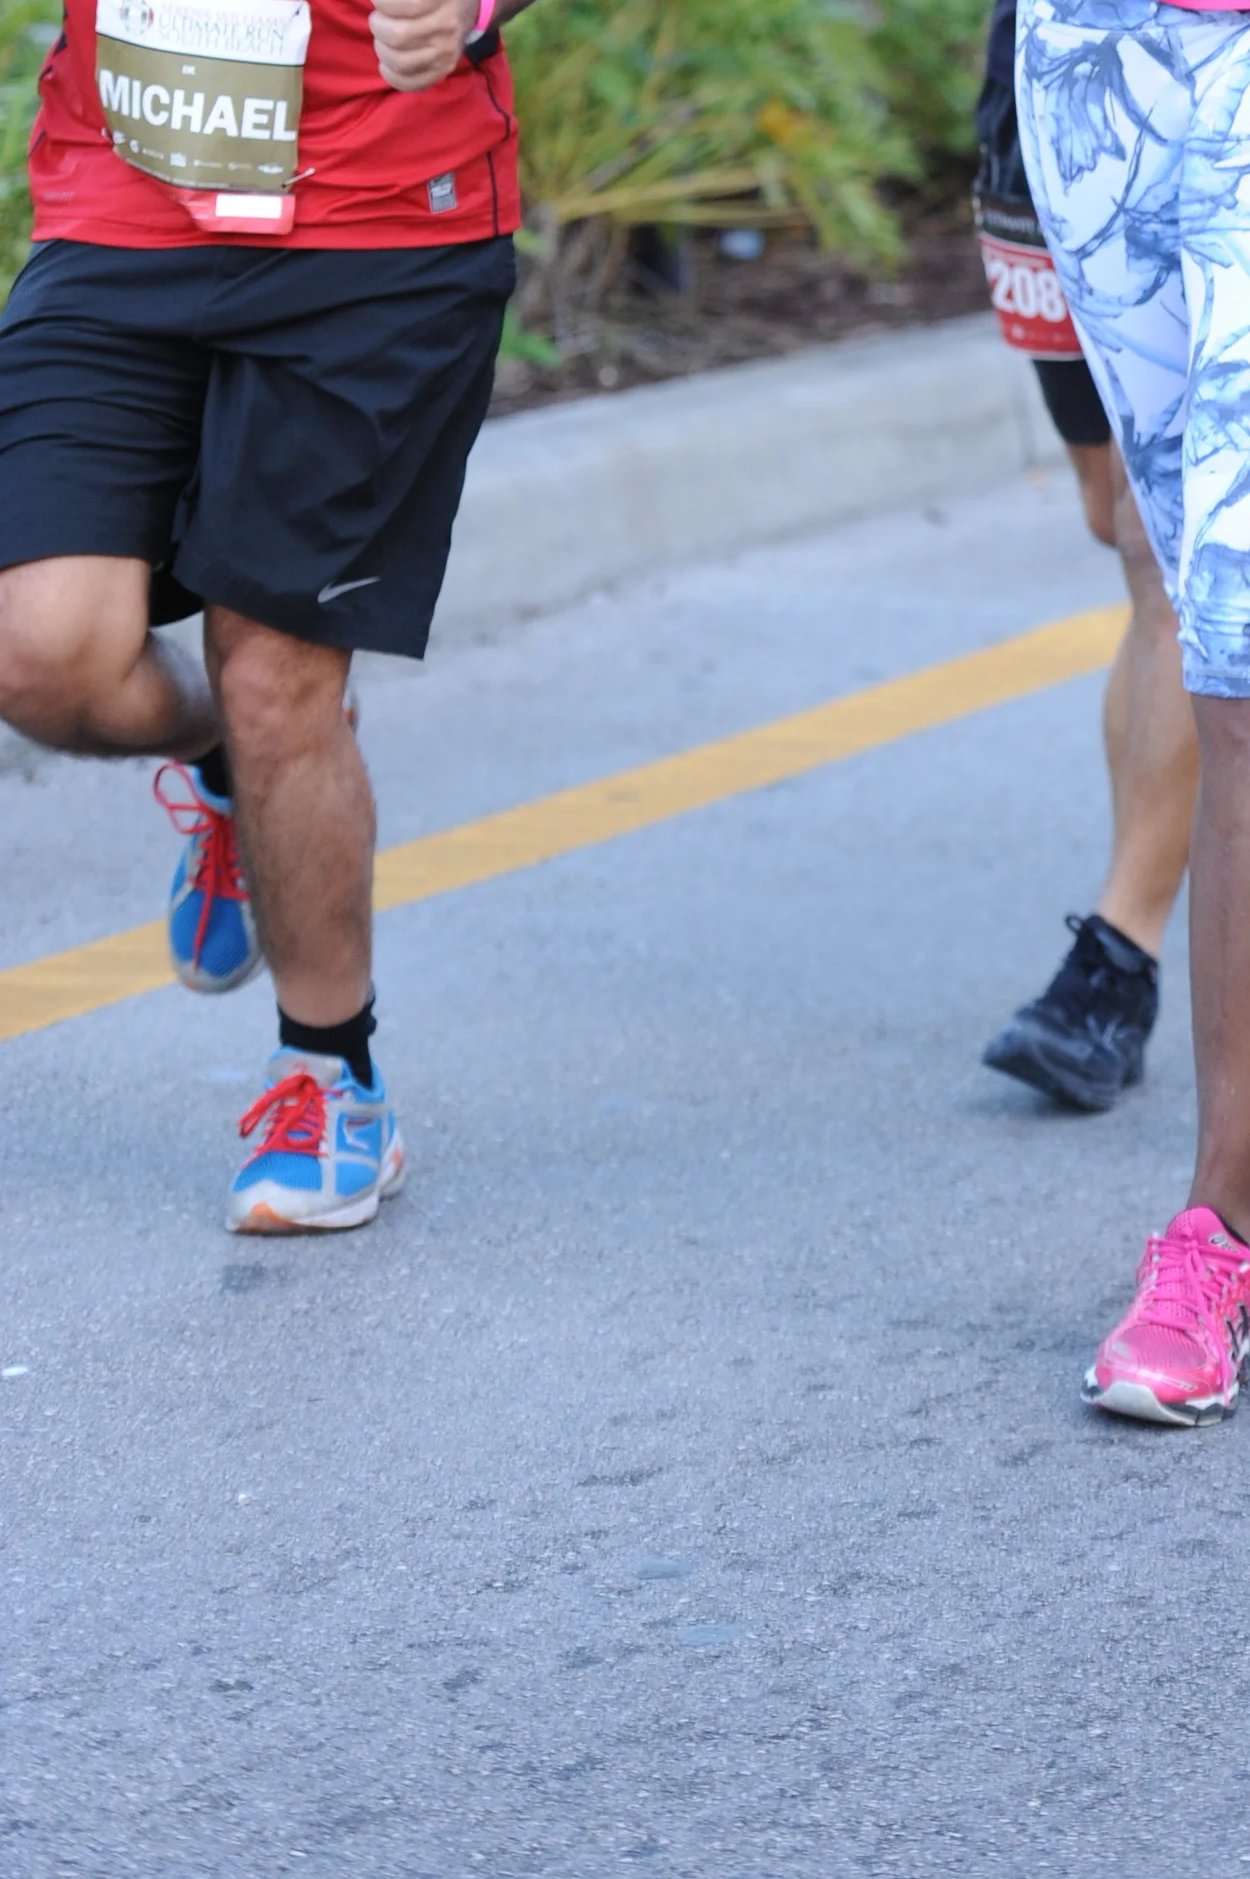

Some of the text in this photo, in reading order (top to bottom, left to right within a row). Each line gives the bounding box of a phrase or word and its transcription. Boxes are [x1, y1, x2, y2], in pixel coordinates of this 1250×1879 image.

[158, 12, 236, 36] ULTIMATE
[245, 25, 285, 41] RUN
[100, 69, 297, 142] MICHAEL
